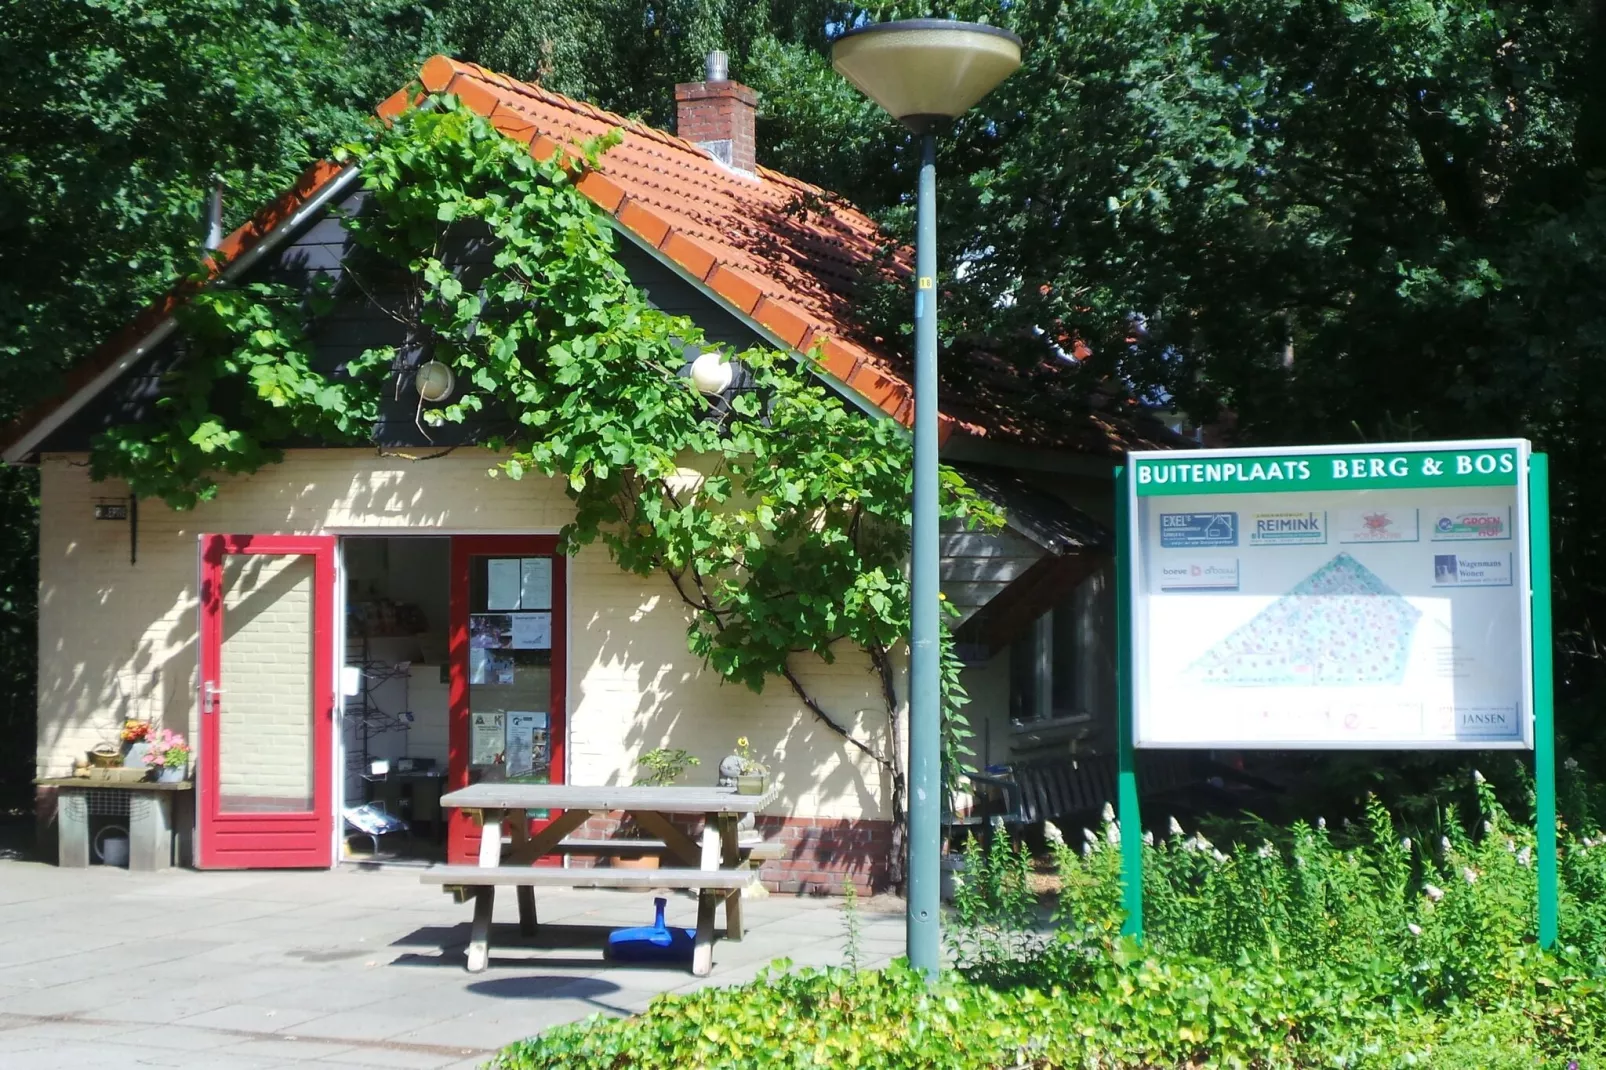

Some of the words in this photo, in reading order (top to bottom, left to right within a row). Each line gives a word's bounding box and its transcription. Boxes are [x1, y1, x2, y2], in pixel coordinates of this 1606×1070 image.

[1138, 460, 1310, 484] BUITENPLAATS
[1332, 457, 1408, 479] BERG
[1421, 457, 1443, 476] &
[1456, 453, 1513, 475] BOS
[1463, 516, 1500, 526] GROEN
[1458, 559, 1502, 569] Wagenmans
[1459, 569, 1485, 577] Wonen
[1463, 714, 1506, 726] JANSEN
